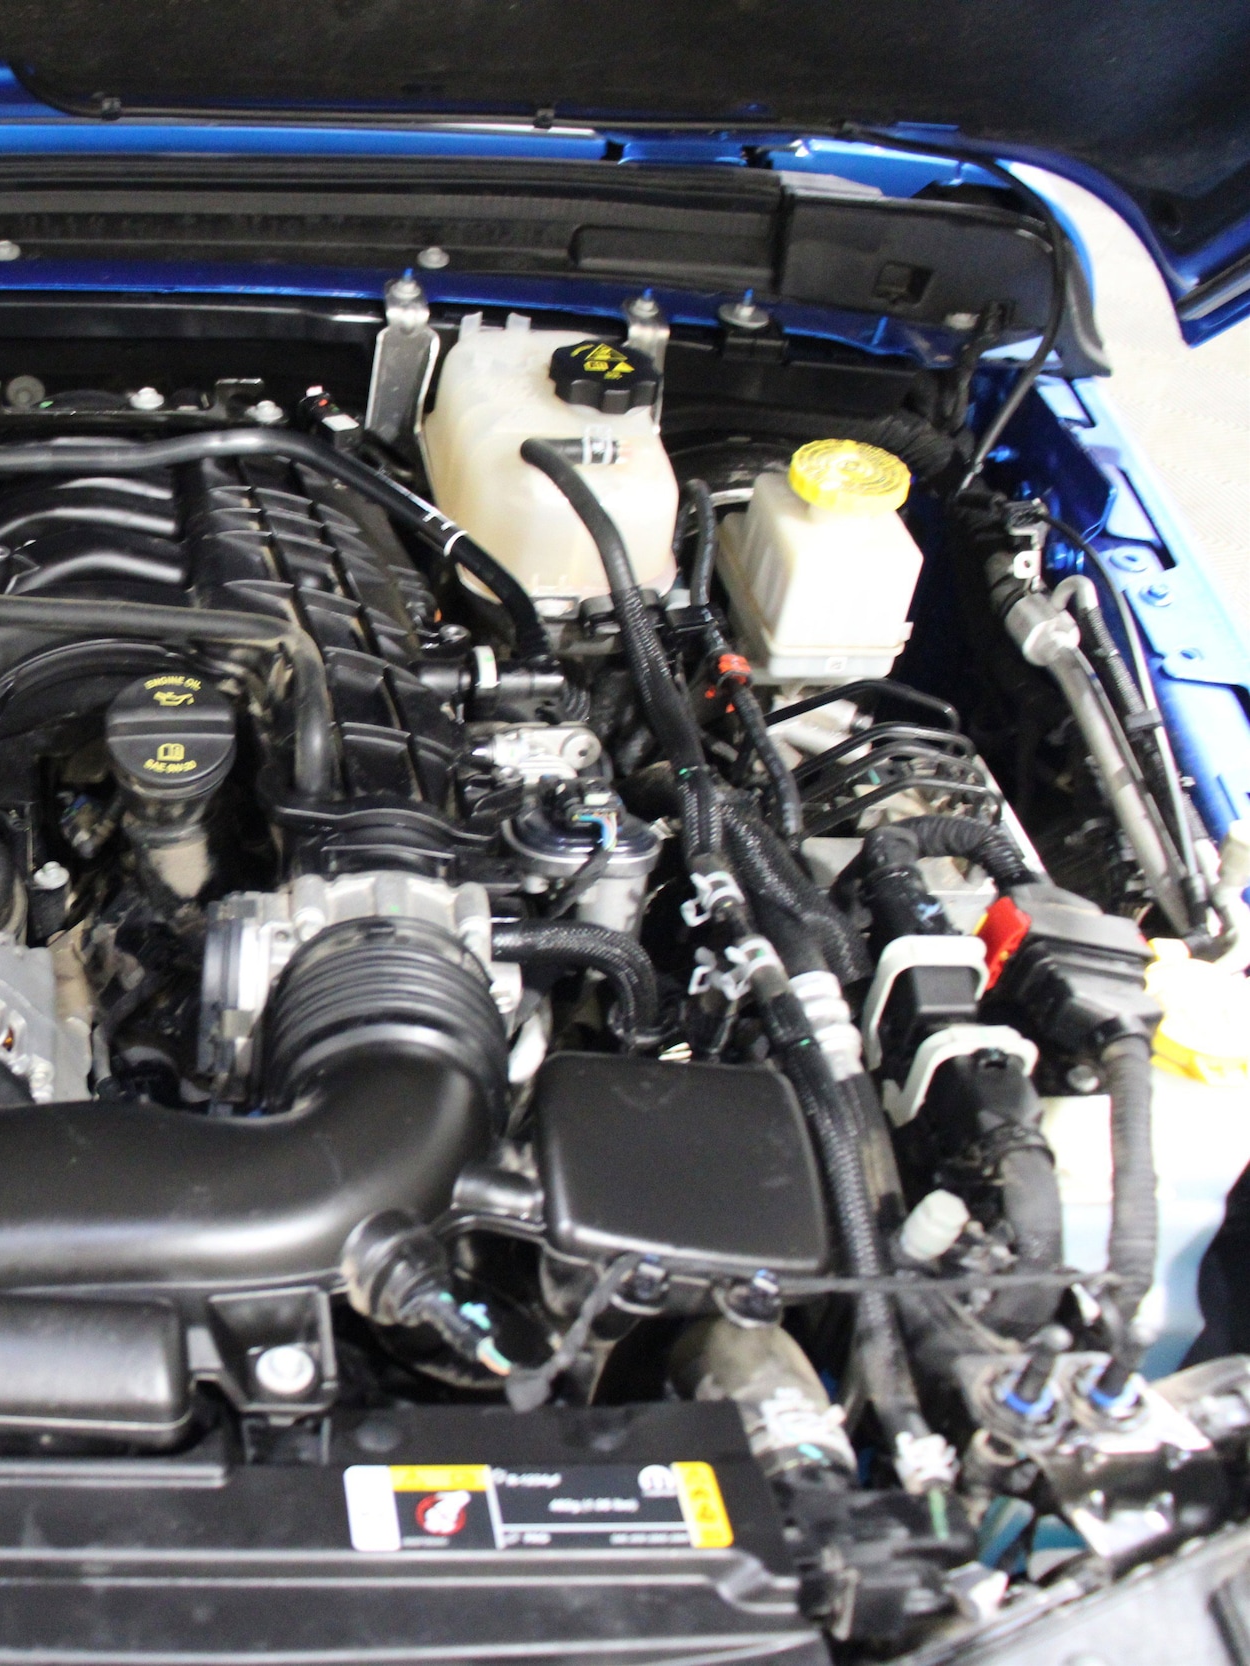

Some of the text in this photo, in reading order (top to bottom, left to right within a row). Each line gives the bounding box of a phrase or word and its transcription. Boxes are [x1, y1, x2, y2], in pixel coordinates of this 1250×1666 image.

[143, 676, 202, 691] ENGINE OIL
[143, 758, 166, 773] SAE
